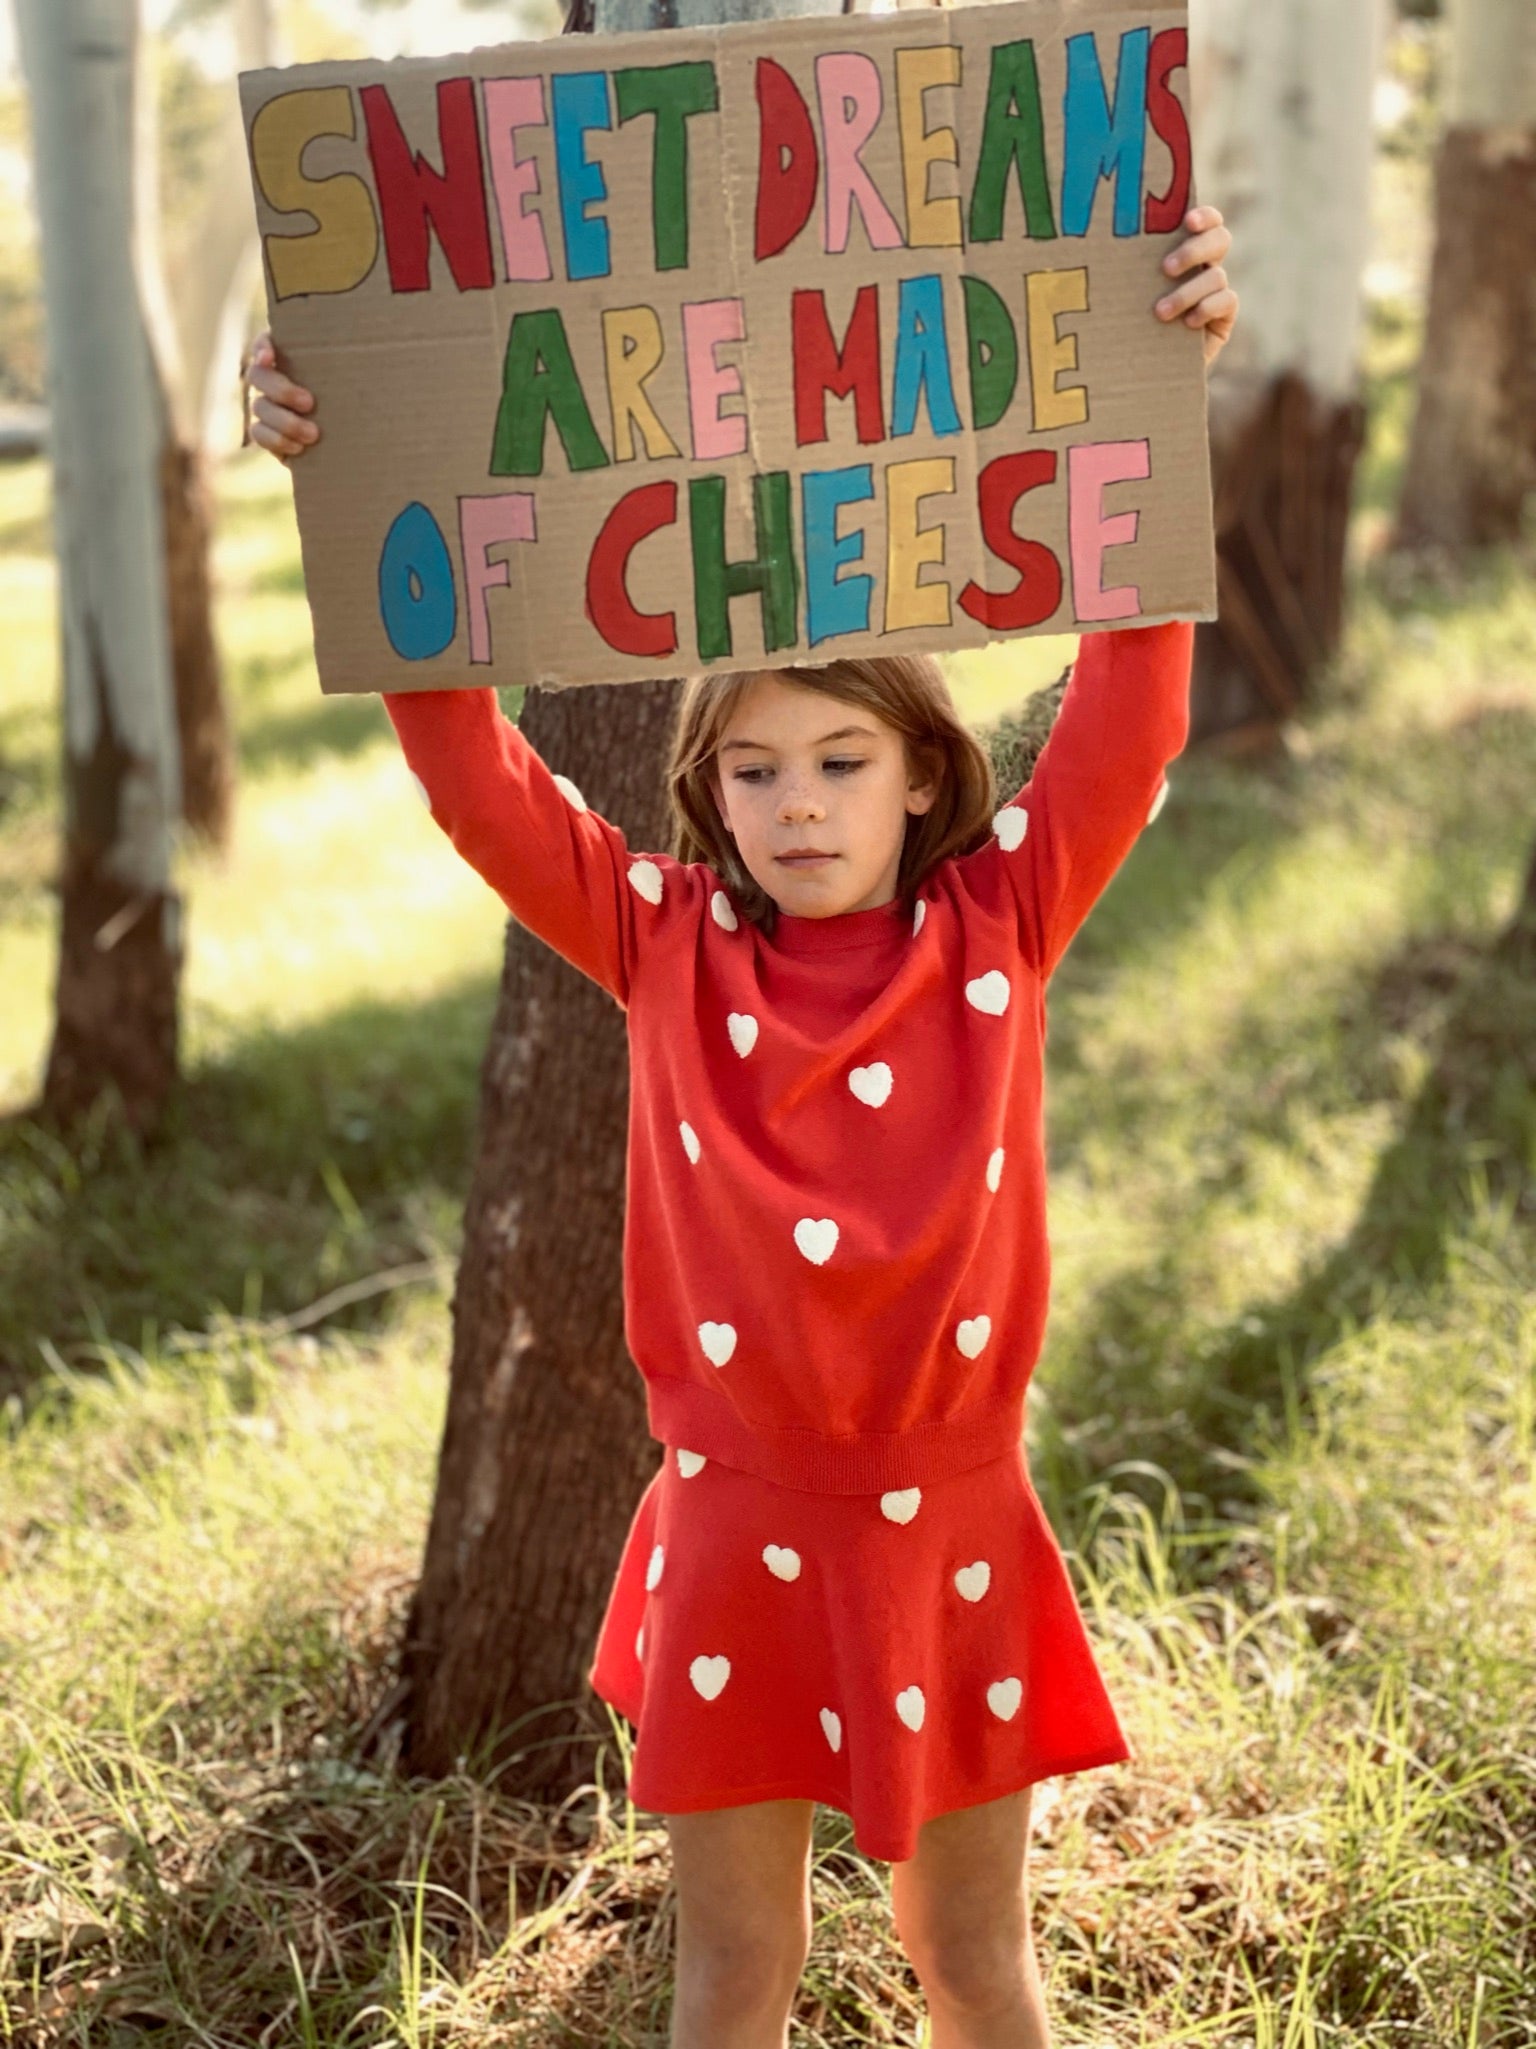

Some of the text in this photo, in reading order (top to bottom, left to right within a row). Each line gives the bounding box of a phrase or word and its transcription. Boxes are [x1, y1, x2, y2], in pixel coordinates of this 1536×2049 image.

[251, 26, 1192, 302] SWEET DREAMS
[488, 266, 1090, 477] ARE MADE
[378, 437, 1151, 666] OF CHEESE
